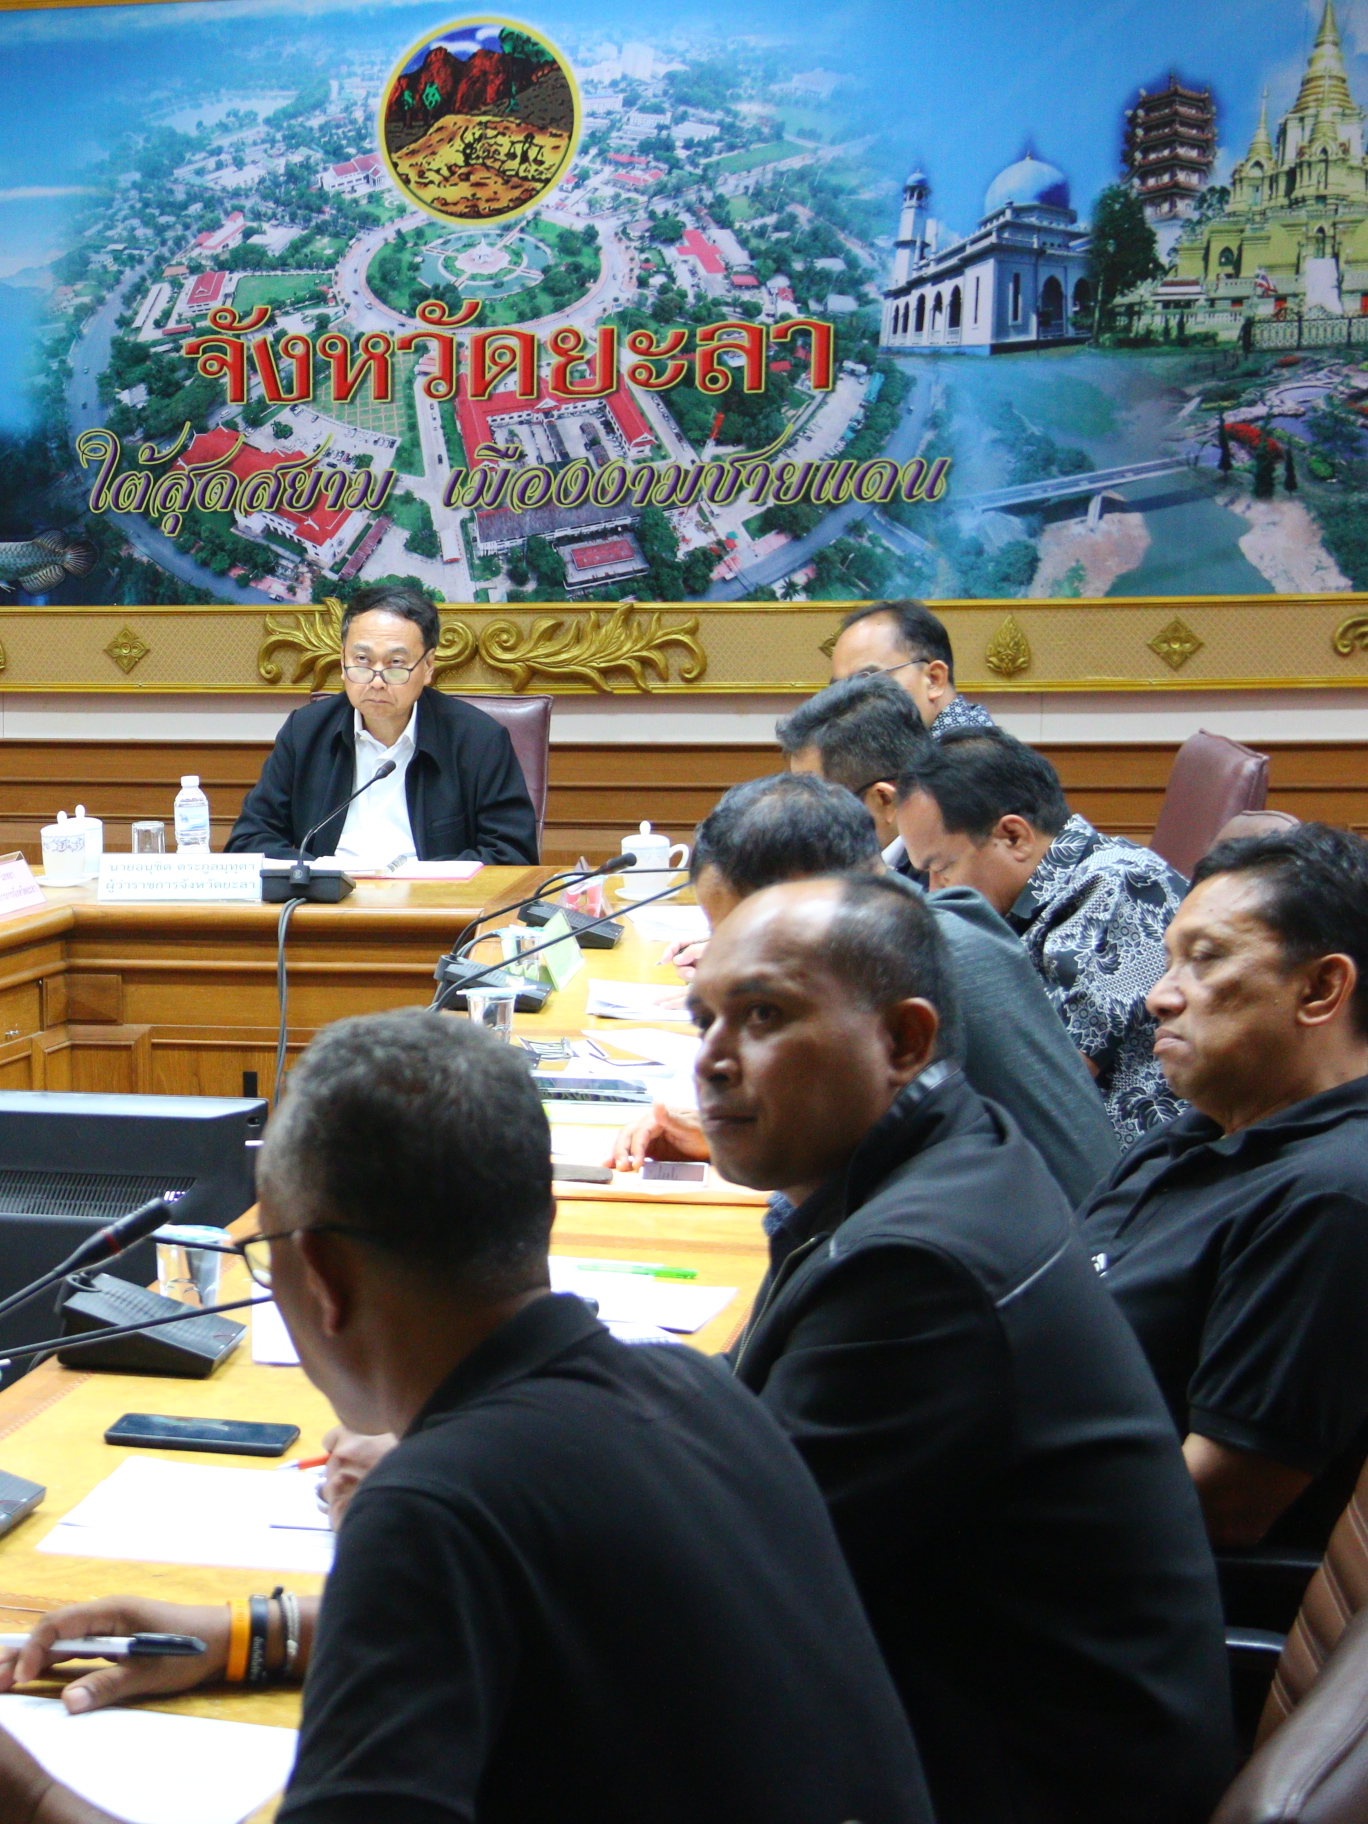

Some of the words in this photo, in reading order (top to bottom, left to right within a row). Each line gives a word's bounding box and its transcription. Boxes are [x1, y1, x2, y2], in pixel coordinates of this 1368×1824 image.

[183, 300, 835, 405] จังหวัดยะลา
[74, 421, 397, 537] ใต้สุดสยาม
[442, 425, 953, 514] เมืองงามชายแดน
